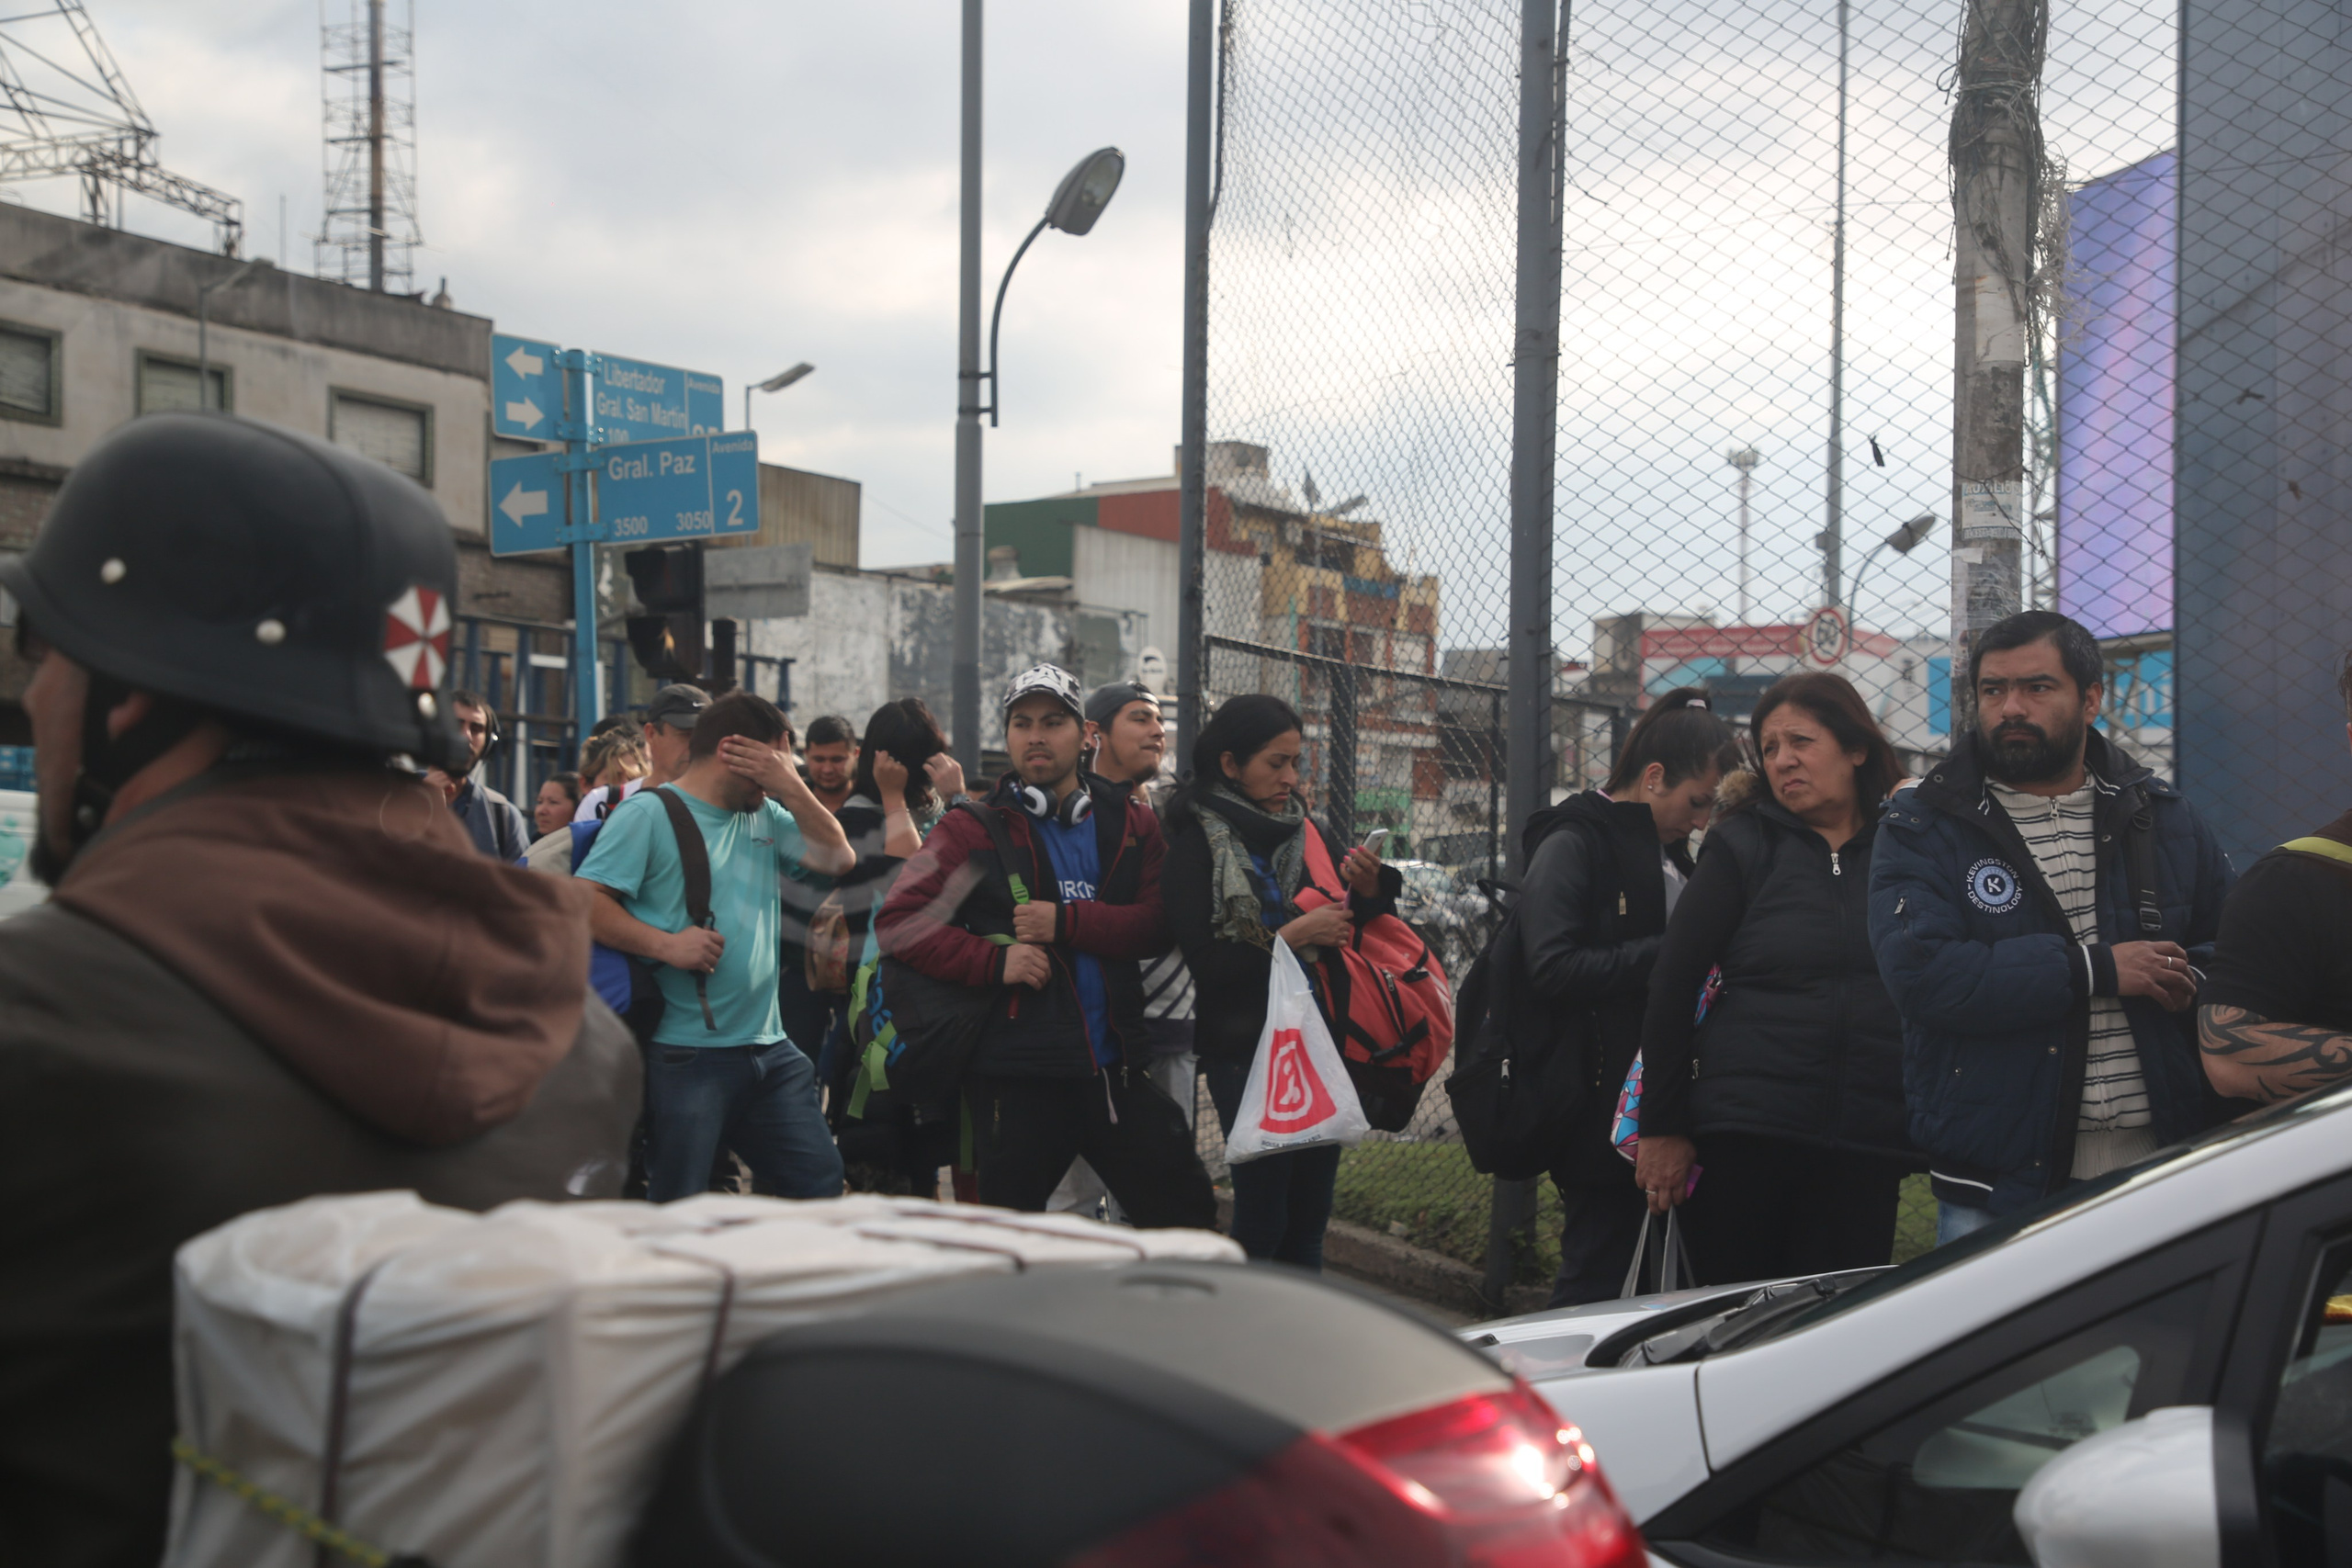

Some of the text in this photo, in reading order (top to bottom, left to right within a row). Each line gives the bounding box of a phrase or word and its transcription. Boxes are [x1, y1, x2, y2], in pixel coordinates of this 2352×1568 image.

[604, 362, 666, 394] Libertador
[688, 378, 721, 394] Avenida
[596, 391, 625, 419] Gral.
[627, 397, 649, 423] San
[712, 439, 754, 455] Avenida
[608, 452, 696, 480] Gral. Paz
[726, 490, 744, 526] 2
[614, 516, 649, 537] 3500
[675, 511, 711, 532] 3050
[1966, 858, 2019, 883] KEVINGSTON
[1986, 877, 2002, 893] K
[1967, 886, 2023, 914] DESTINOLOGY
